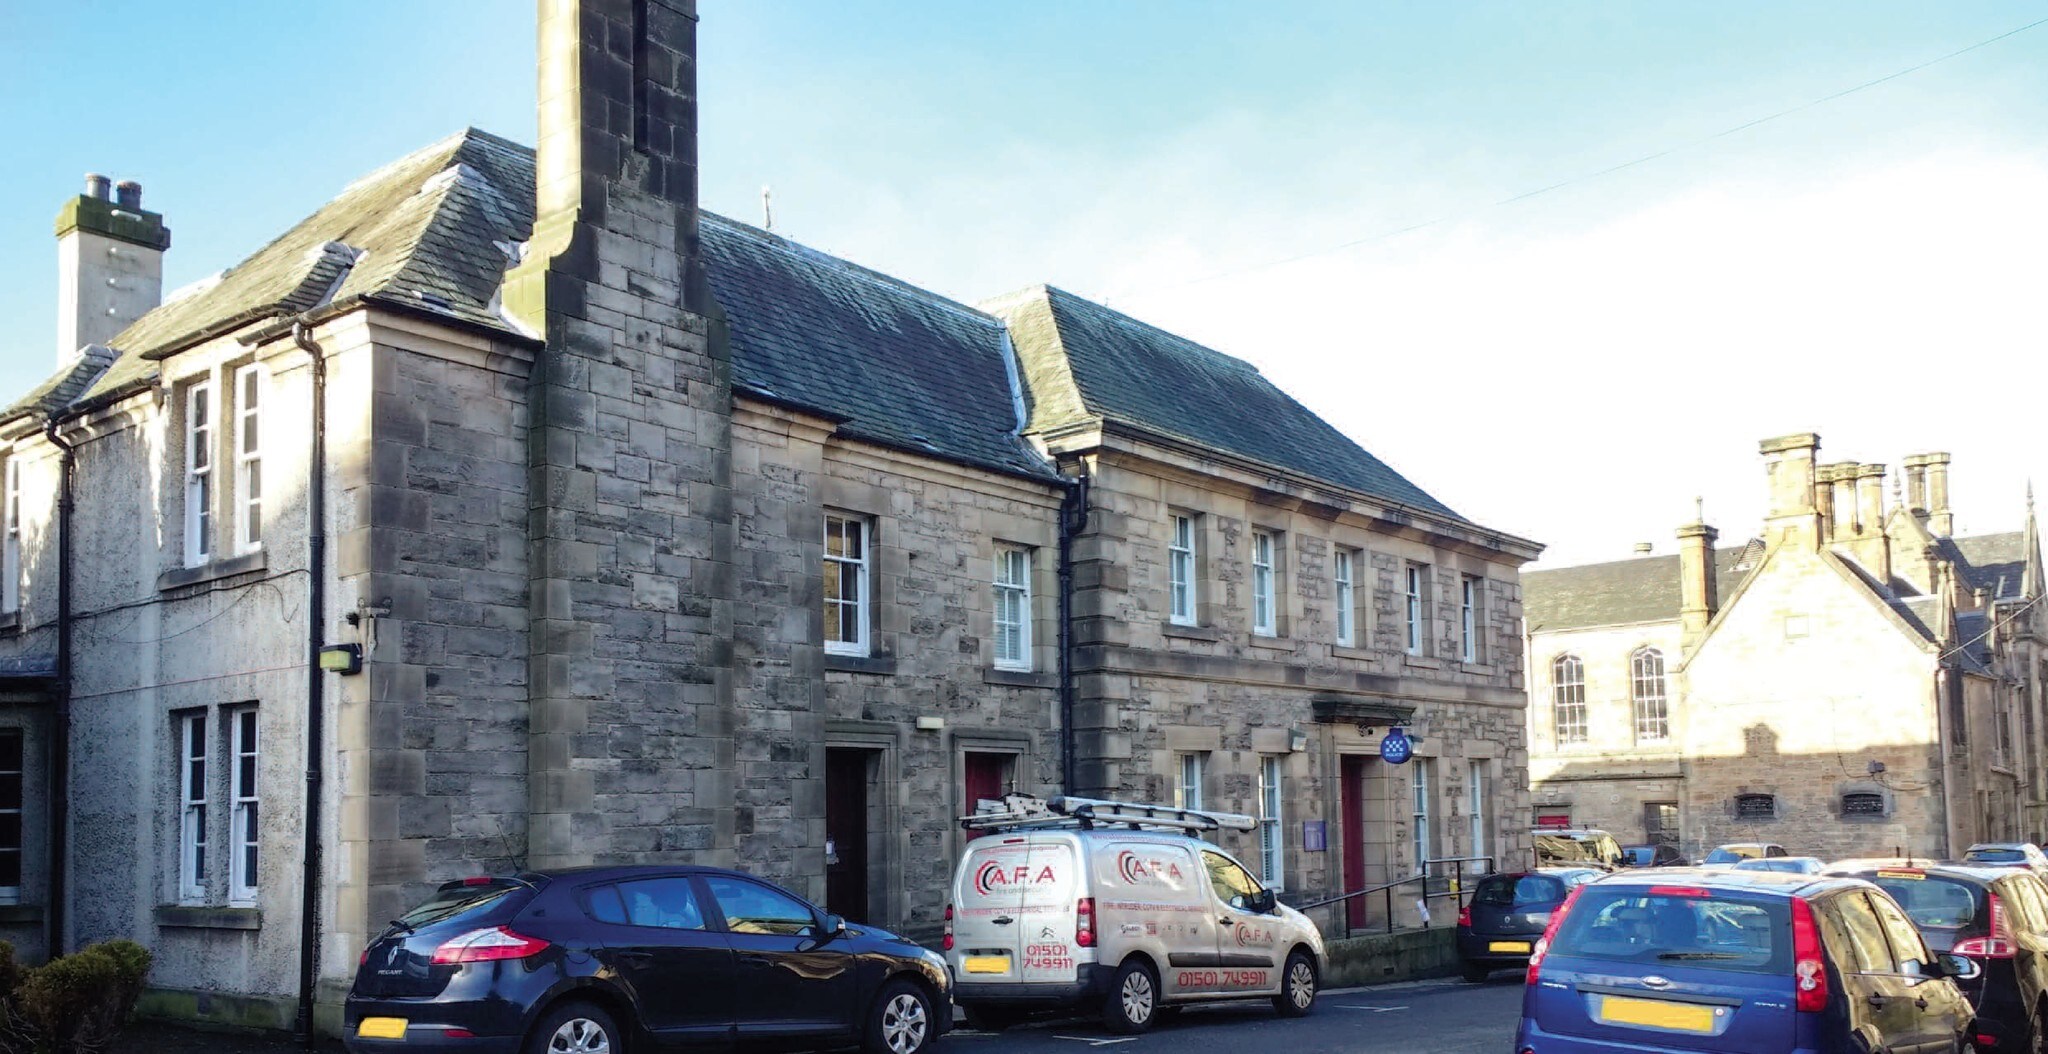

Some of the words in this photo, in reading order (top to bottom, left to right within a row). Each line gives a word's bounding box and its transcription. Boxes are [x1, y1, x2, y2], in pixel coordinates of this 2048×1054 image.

[988, 866, 1055, 885] A.F.A
[1133, 860, 1183, 879] A.FA
[1027, 945, 1067, 956] 01501
[1023, 958, 1073, 969] 749911
[1178, 971, 1218, 987] 01501
[1222, 971, 1267, 986] 749911
